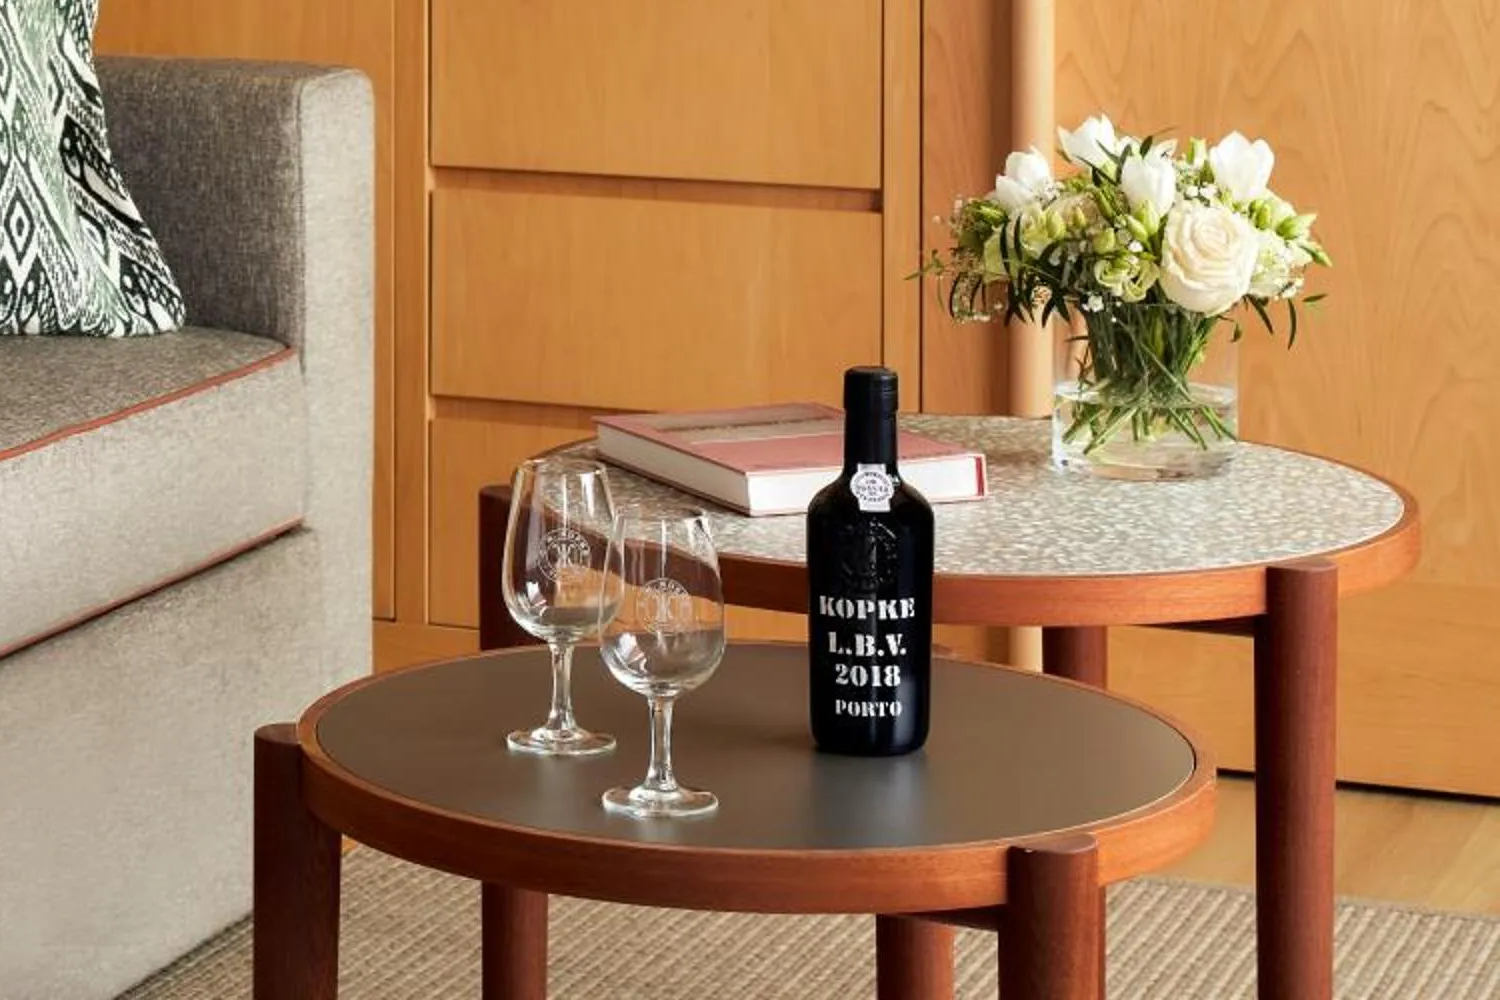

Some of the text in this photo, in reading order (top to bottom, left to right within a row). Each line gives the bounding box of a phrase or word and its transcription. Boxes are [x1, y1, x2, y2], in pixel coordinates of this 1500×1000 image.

[819, 595, 915, 620] KOPKE
[828, 631, 907, 657] L.B.V.
[835, 663, 901, 687] 2018
[835, 698, 903, 717] PORTO
